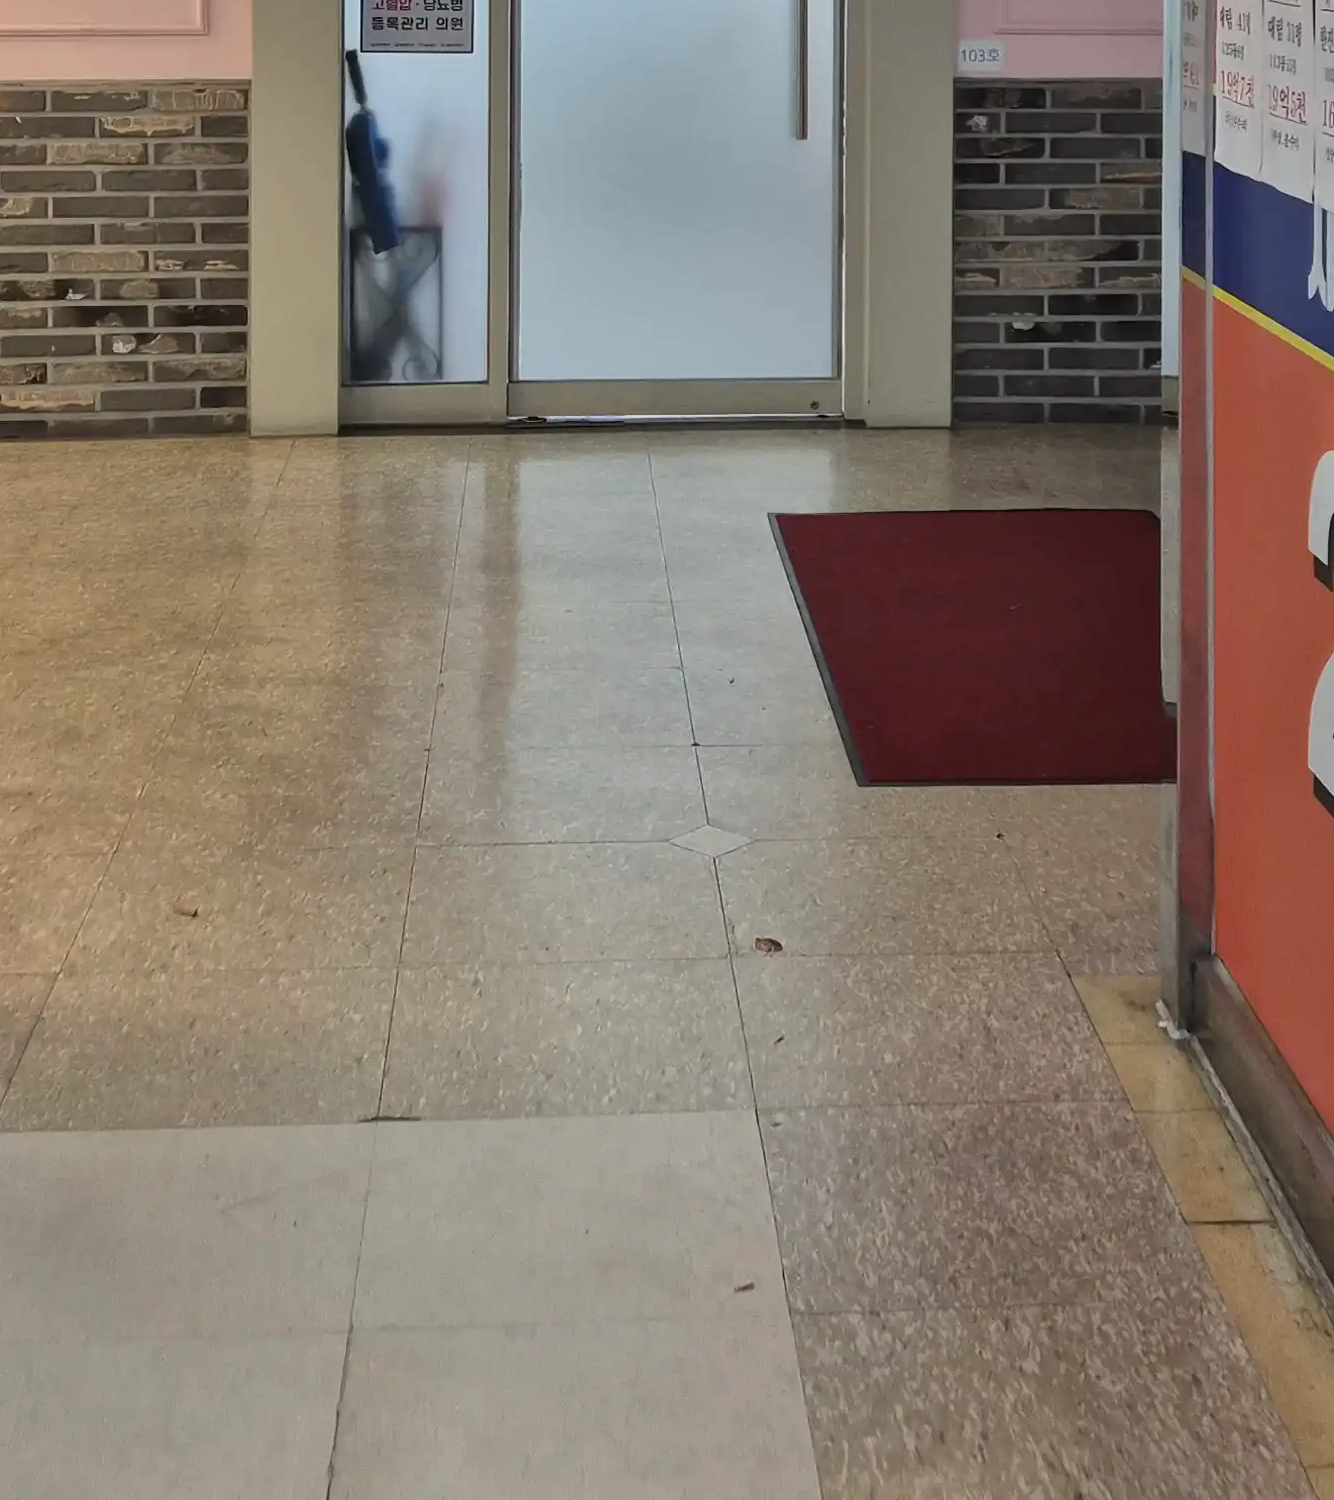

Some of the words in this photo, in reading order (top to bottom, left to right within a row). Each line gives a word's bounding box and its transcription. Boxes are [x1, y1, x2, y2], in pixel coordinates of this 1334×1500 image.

[371, 16, 429, 31] 등록관리
[436, 17, 464, 32] 의원
[960, 48, 1000, 63] 103호
